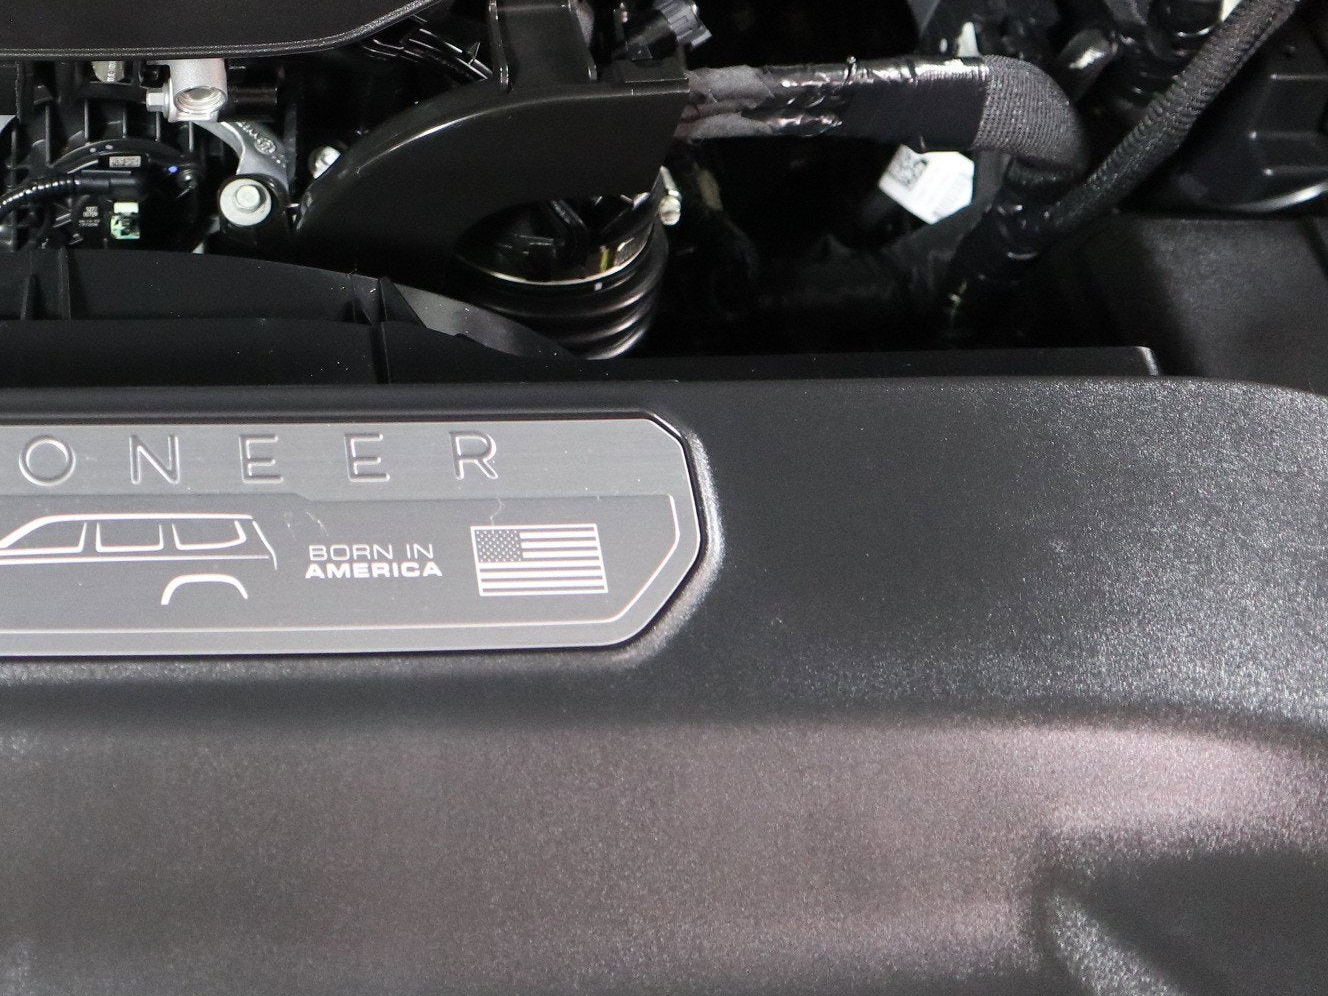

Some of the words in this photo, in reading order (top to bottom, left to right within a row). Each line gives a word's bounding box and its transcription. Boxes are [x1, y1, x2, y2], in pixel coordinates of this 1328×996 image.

[308, 544, 398, 560] BORN
[405, 544, 434, 559] IN
[305, 562, 443, 580] AMERICA
